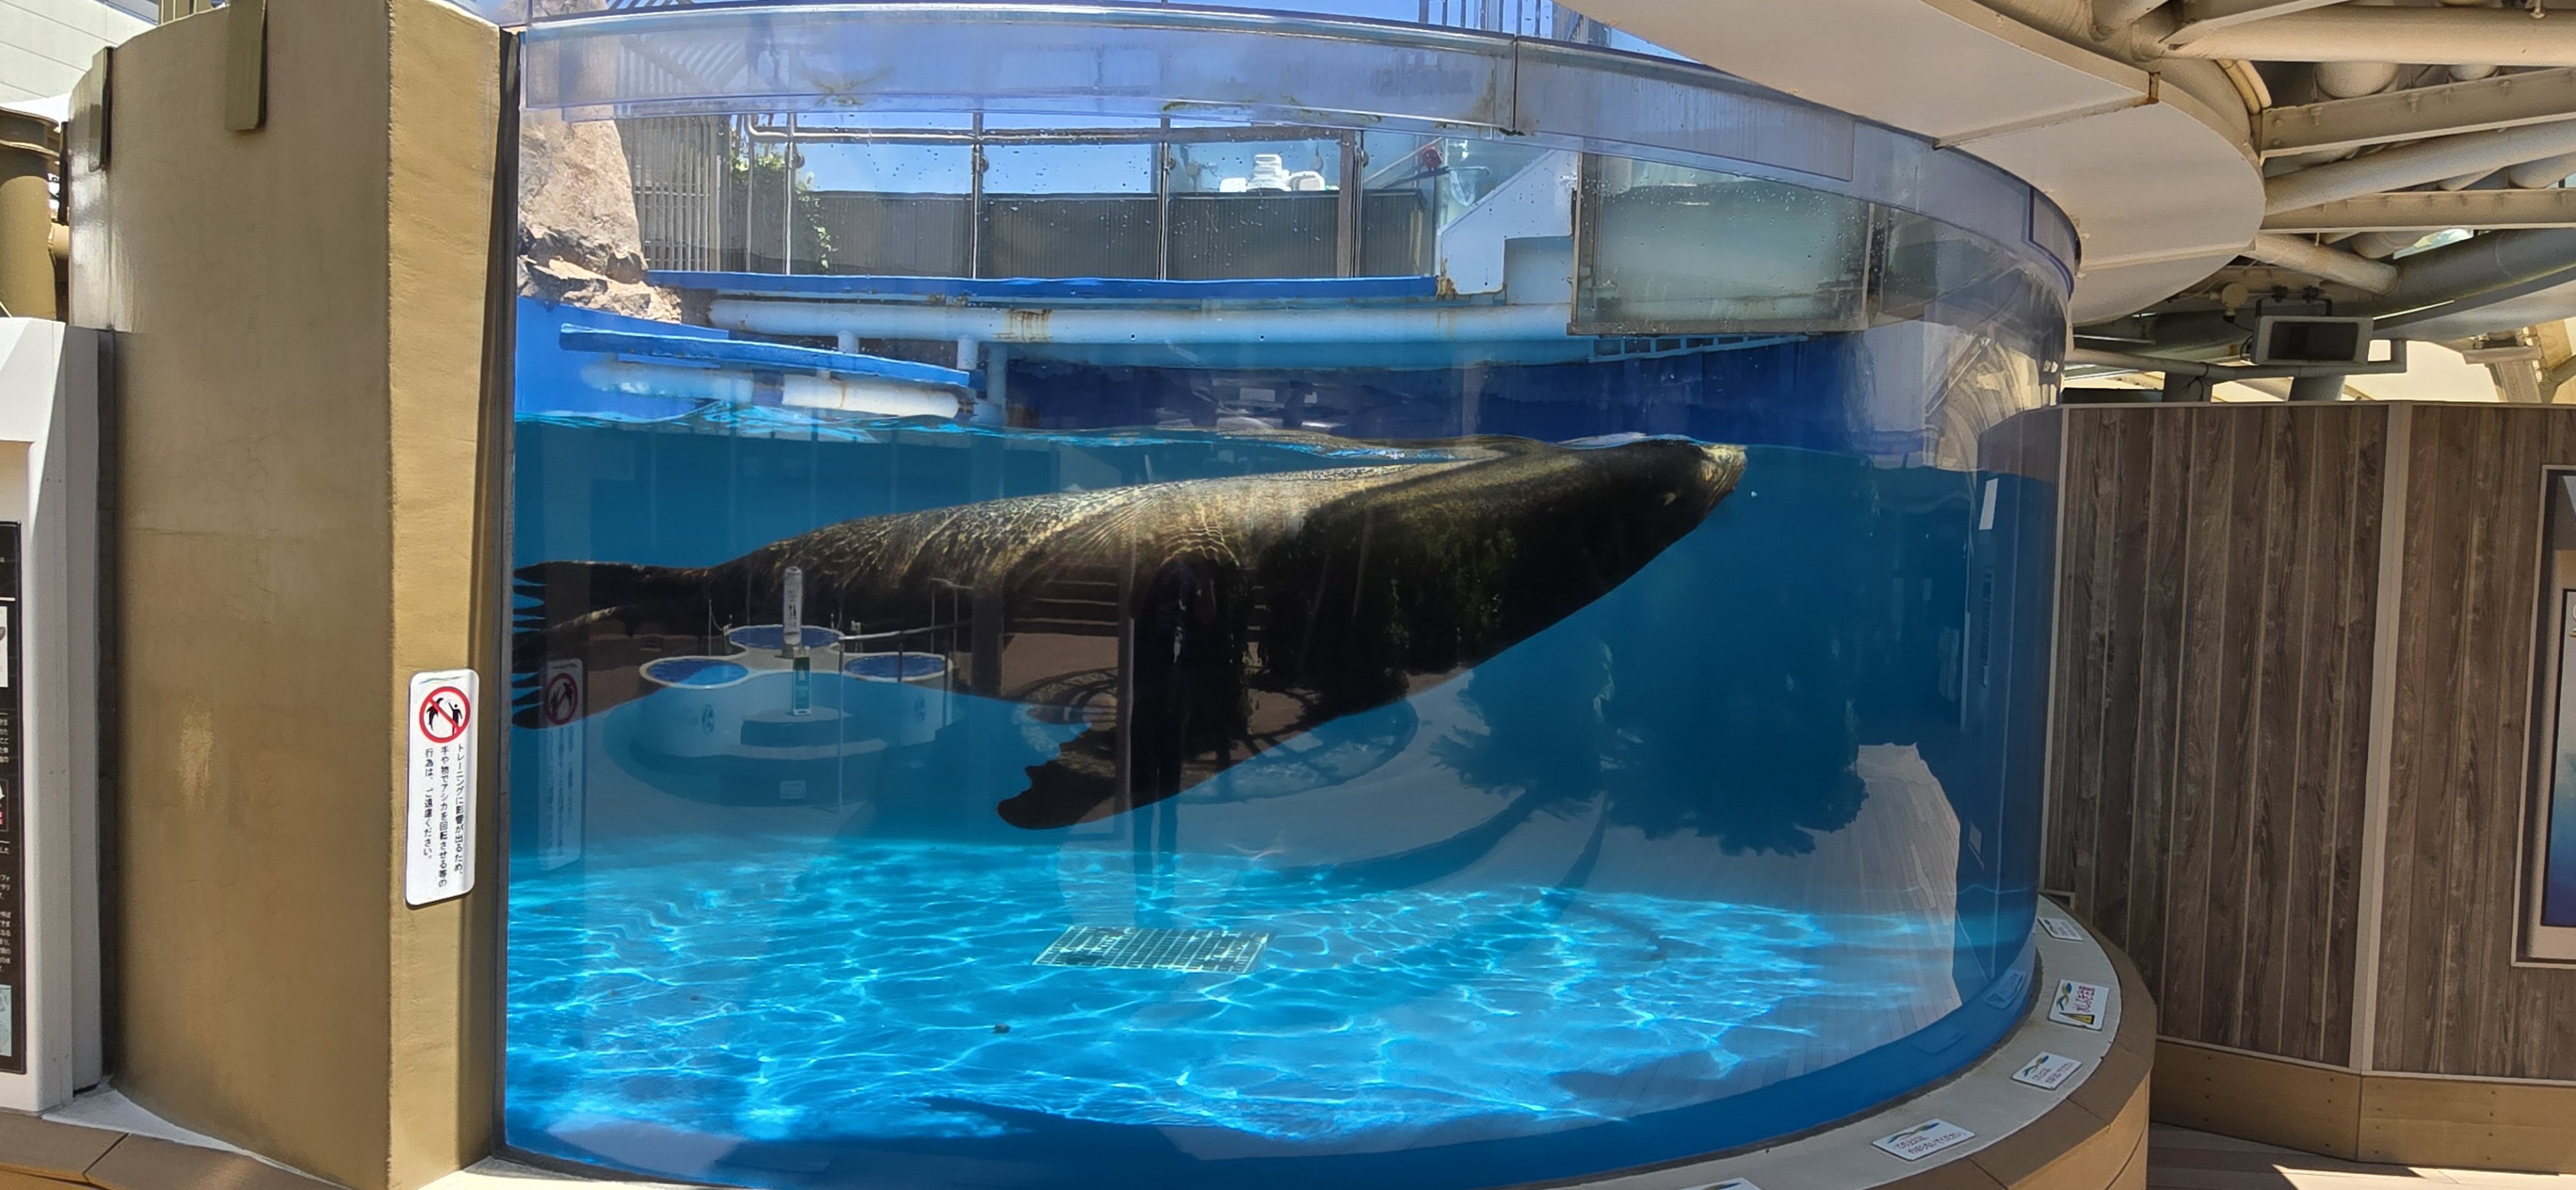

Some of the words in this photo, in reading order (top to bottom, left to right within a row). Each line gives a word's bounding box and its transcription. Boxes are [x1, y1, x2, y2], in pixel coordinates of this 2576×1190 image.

[423, 748, 434, 859] 行為は、ご遠慮ください。
[439, 746, 449, 887] 手や物でアシカを回転させる等の
[455, 744, 464, 874] トレーニングに影響が出るため、
